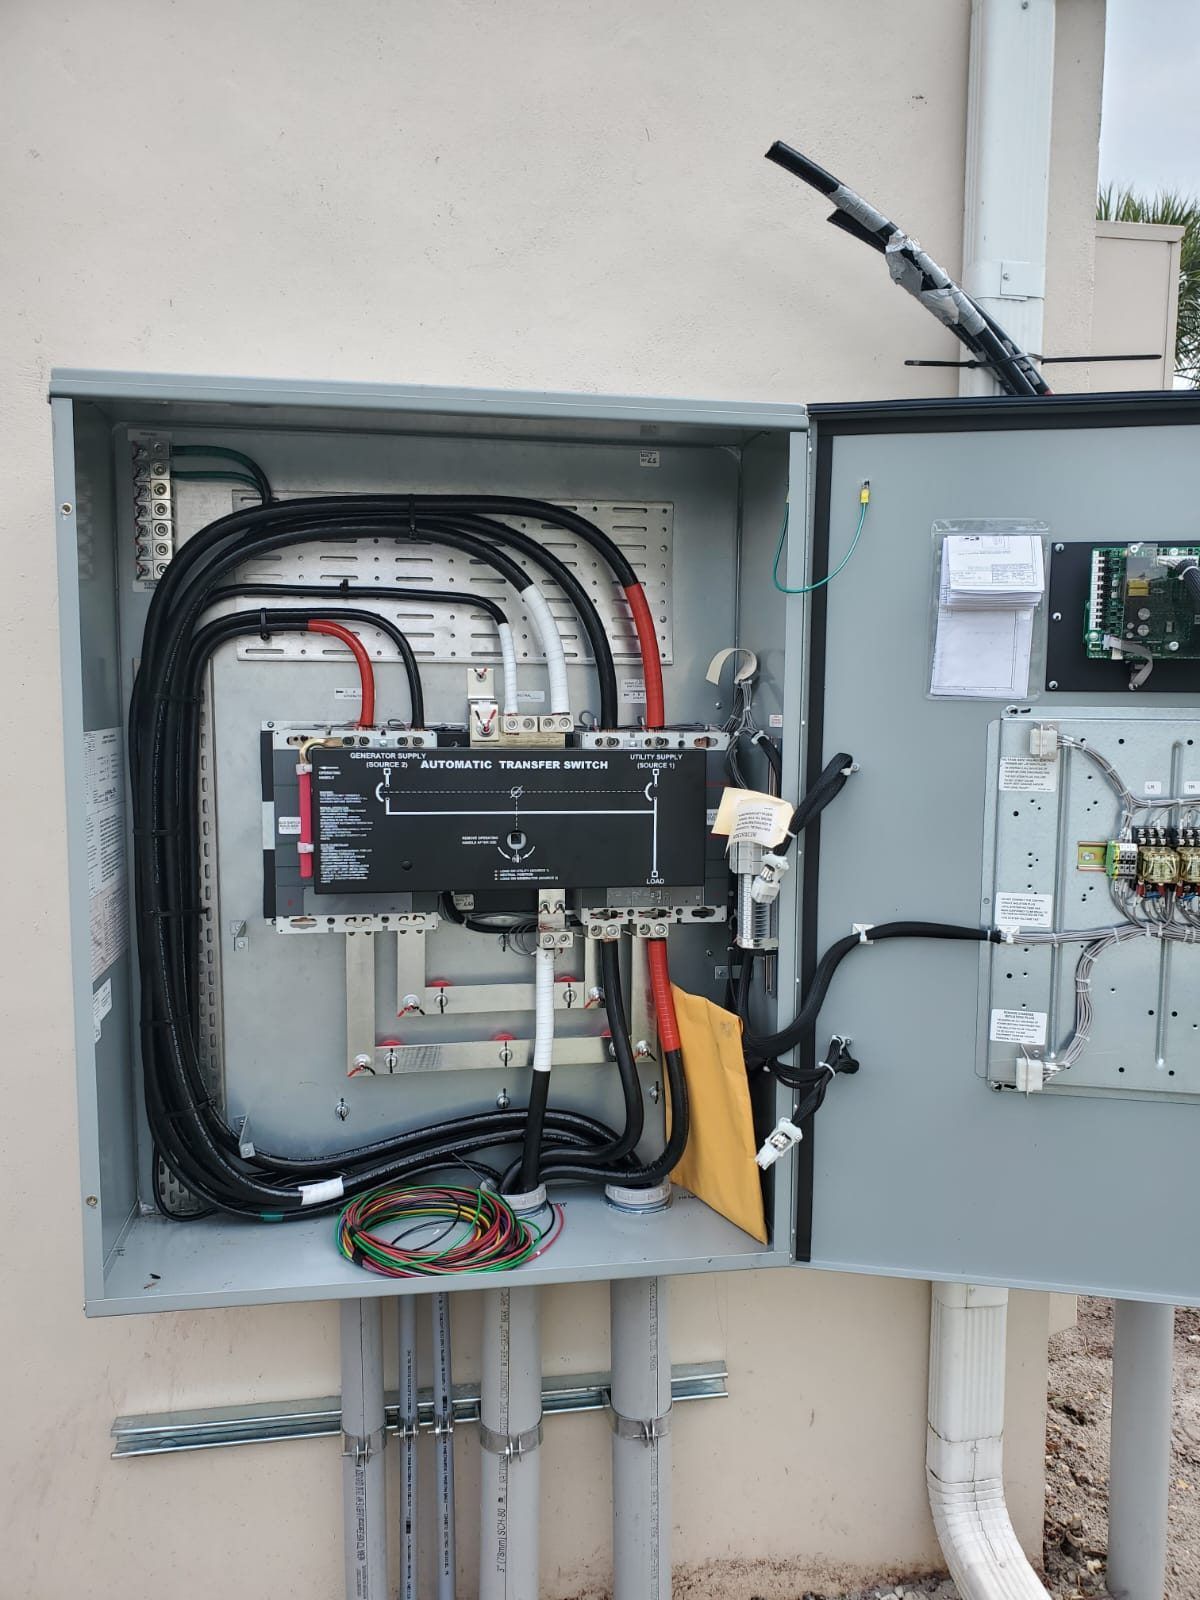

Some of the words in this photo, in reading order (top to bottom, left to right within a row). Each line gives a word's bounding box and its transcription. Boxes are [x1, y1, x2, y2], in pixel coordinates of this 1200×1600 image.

[366, 761, 400, 769] (SOURCE
[401, 761, 408, 769] 2)
[420, 760, 493, 770] AUTOMATIC
[499, 760, 561, 770] TRANSFER
[563, 760, 609, 770] SWITCH
[496, 1508, 506, 1536] SCH-80
[496, 1537, 507, 1564] (78mm)
